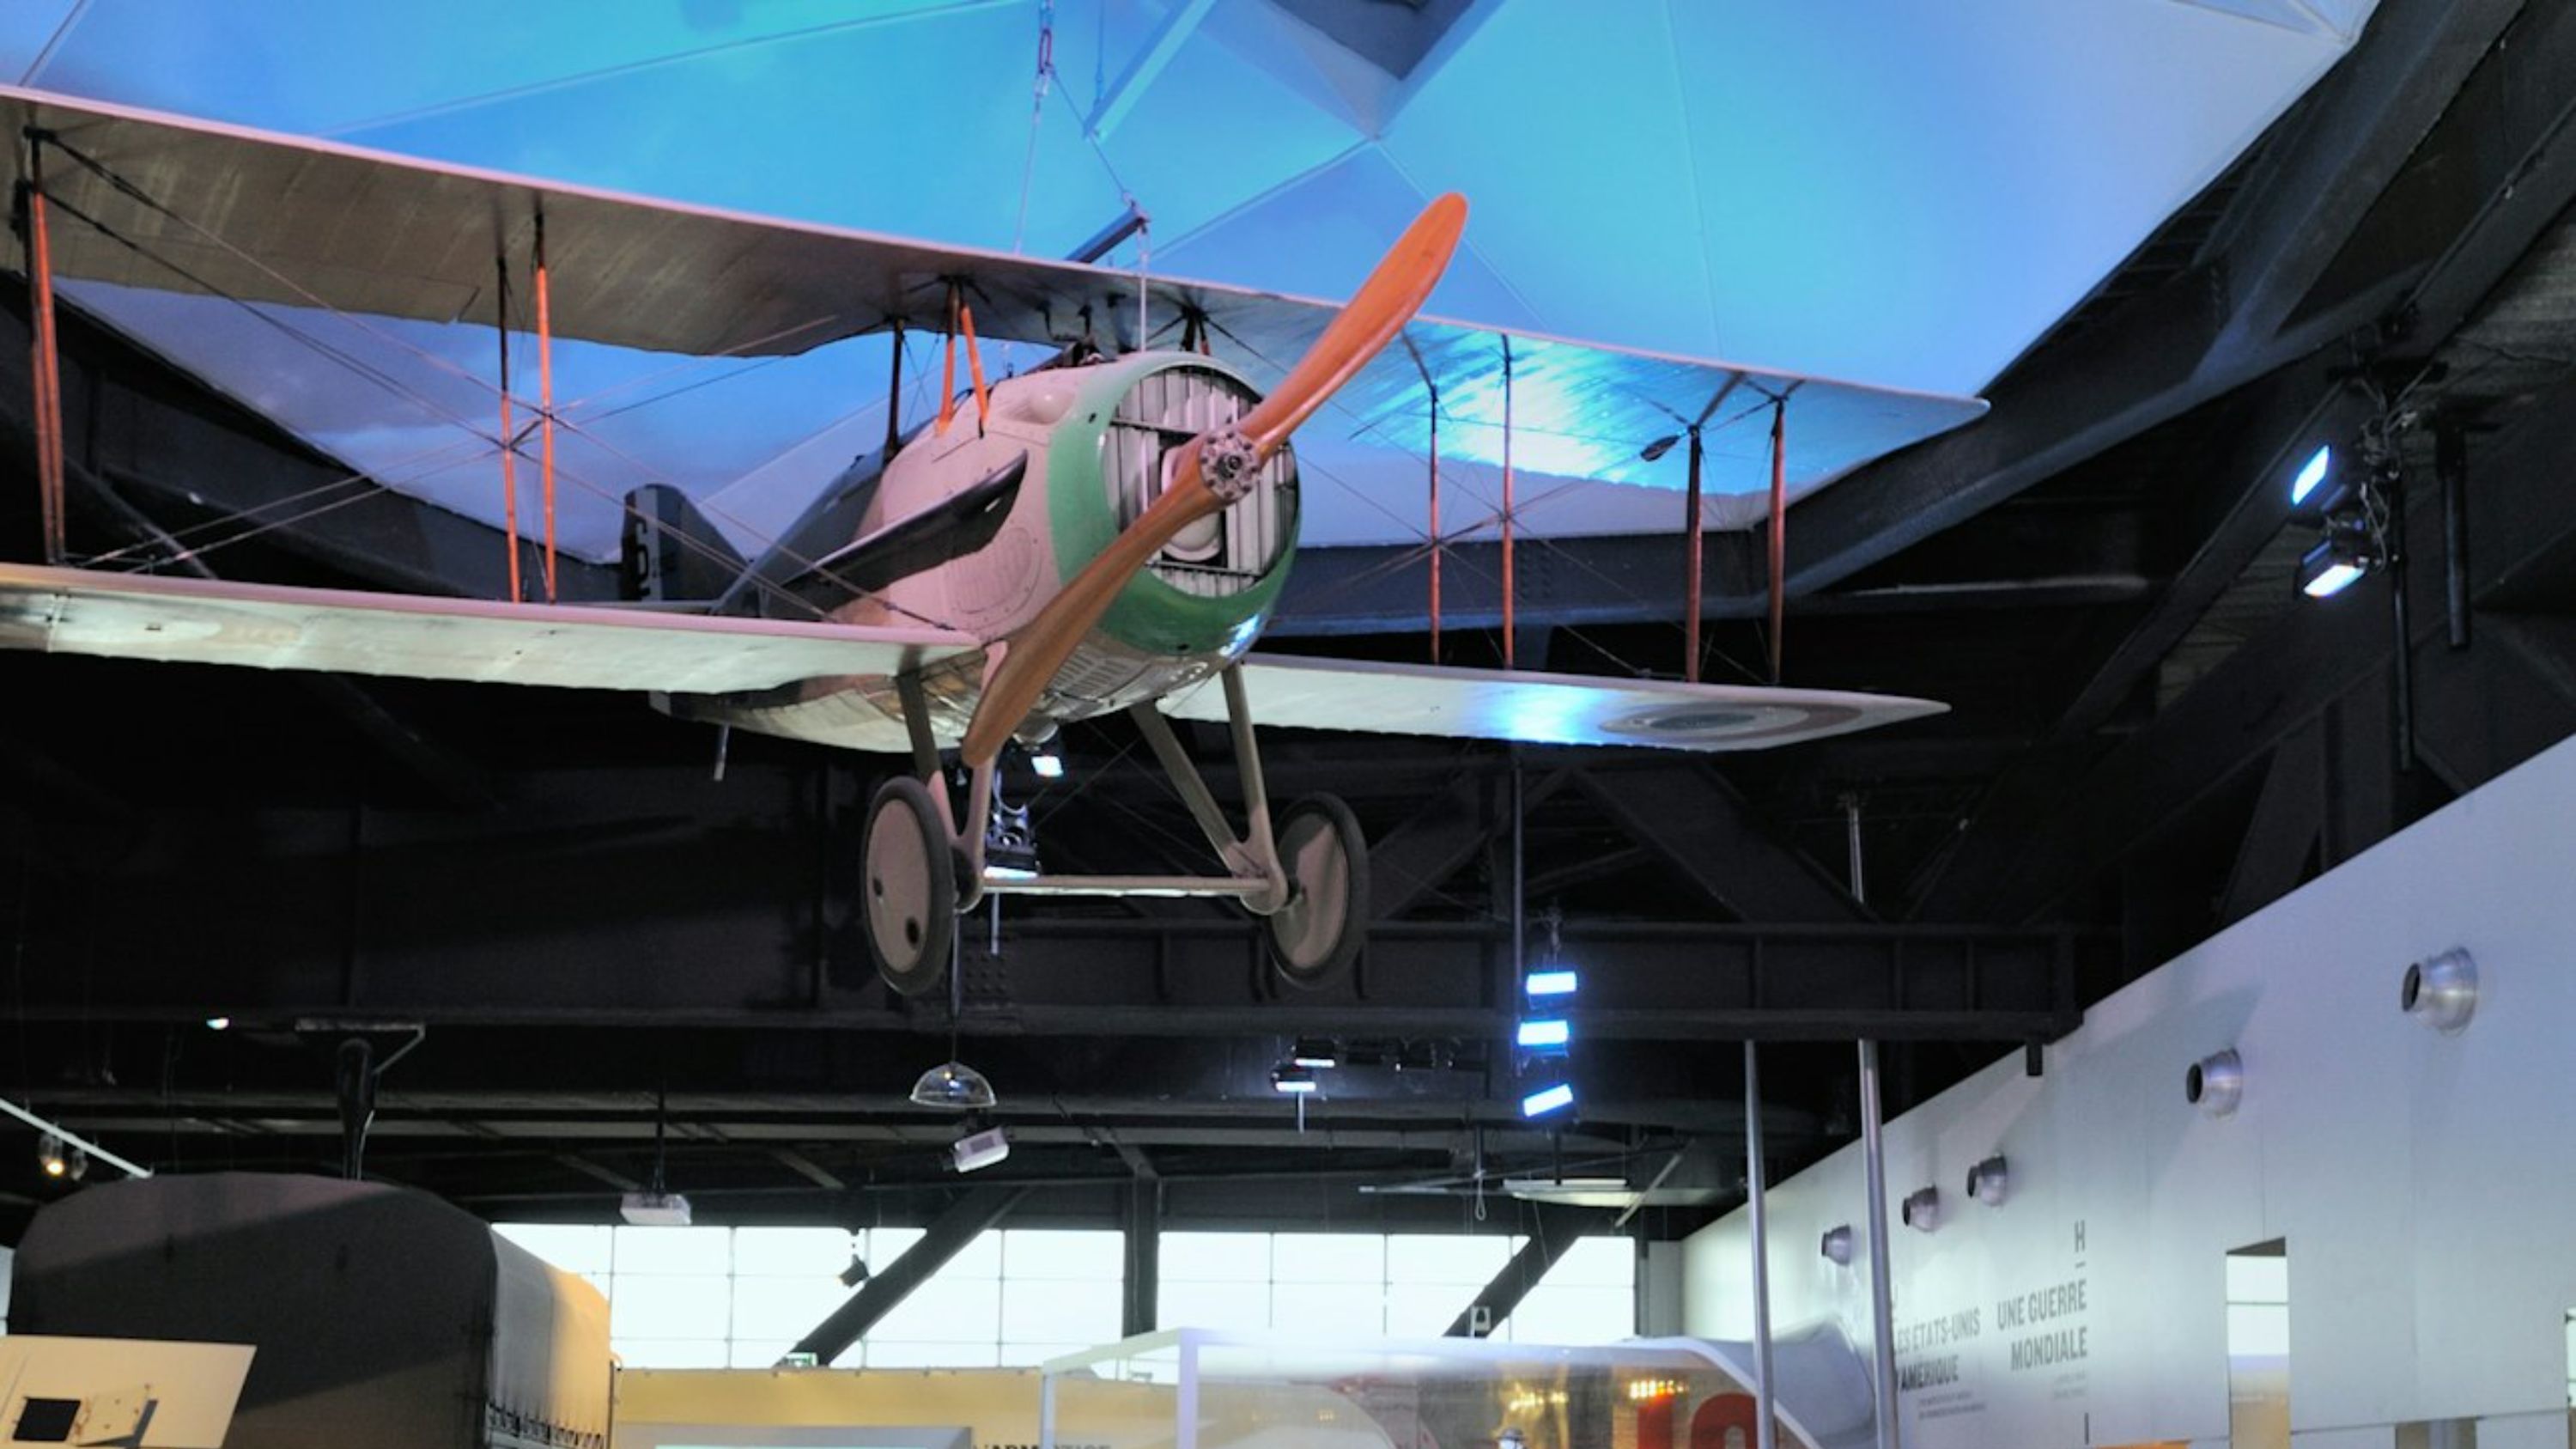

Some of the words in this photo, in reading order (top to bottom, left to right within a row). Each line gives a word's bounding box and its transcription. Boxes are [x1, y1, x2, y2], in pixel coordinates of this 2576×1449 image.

[2074, 1220, 2086, 1251] H
[1996, 1296, 2025, 1330] UNE
[2028, 1280, 2087, 1324] GUERRE
[2010, 1327, 2087, 1371] MONDIALE
